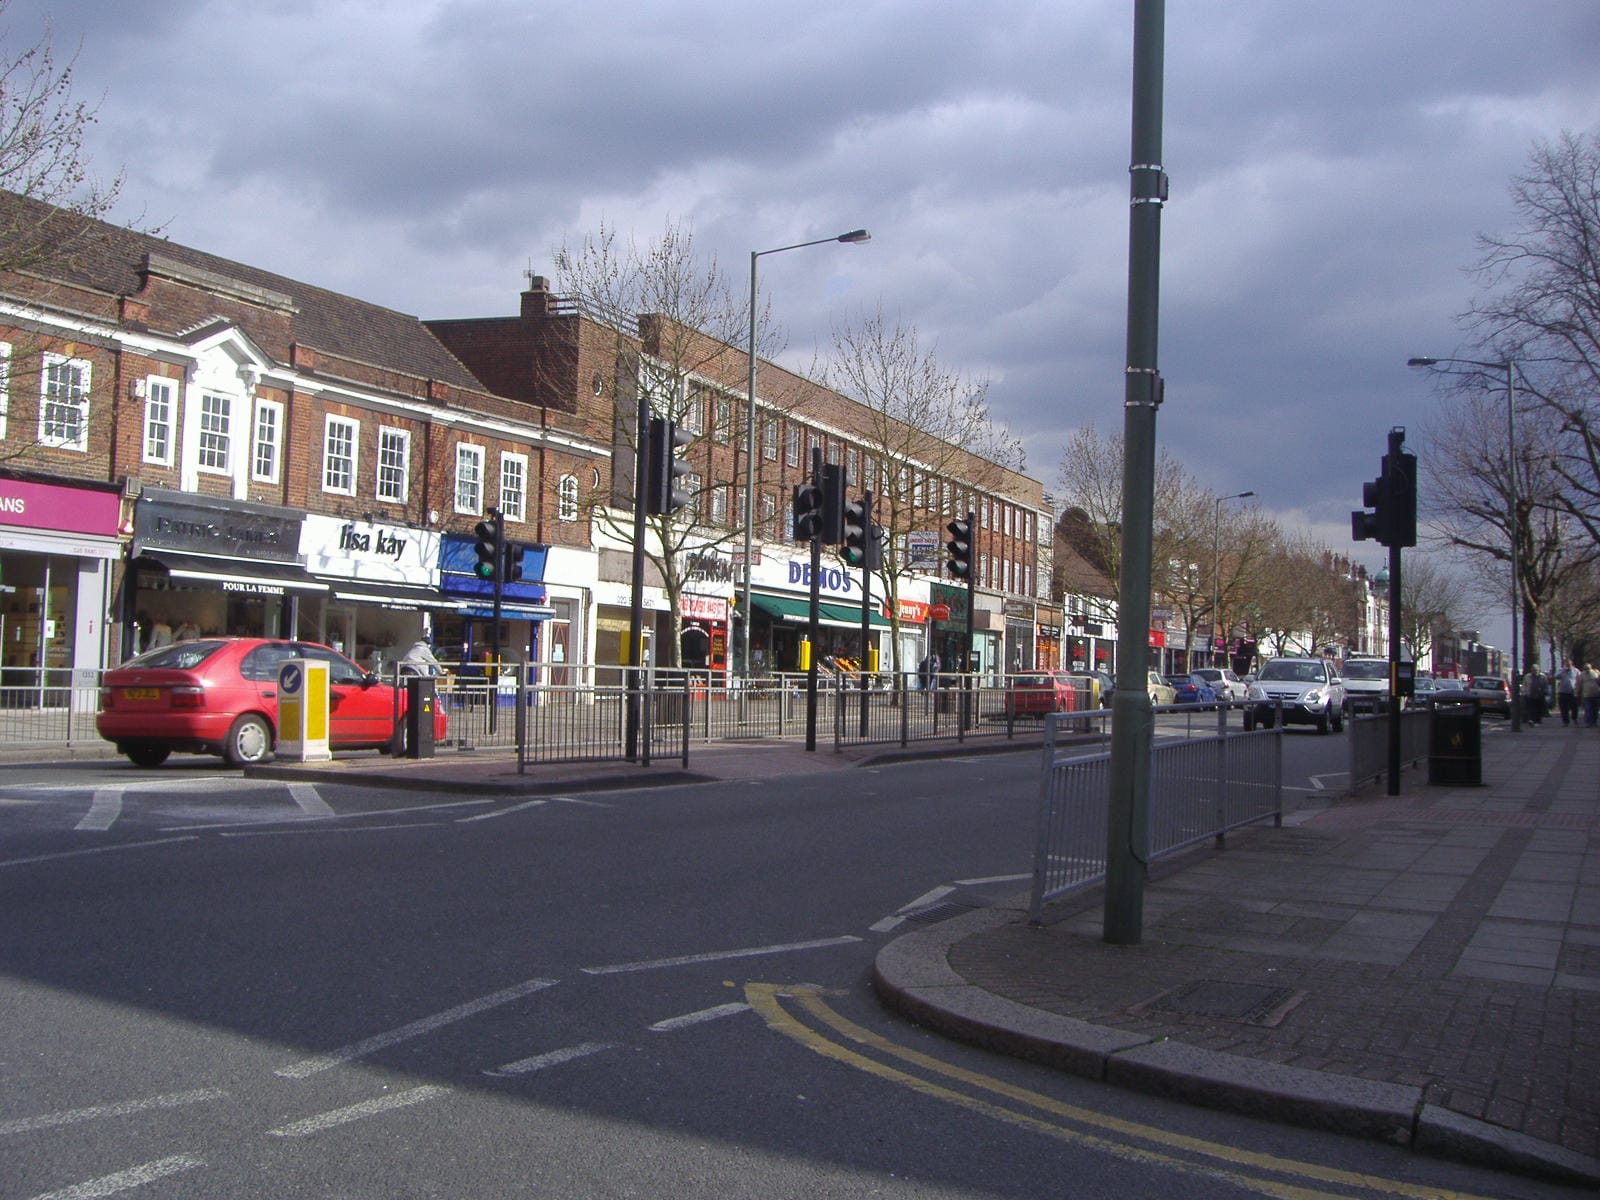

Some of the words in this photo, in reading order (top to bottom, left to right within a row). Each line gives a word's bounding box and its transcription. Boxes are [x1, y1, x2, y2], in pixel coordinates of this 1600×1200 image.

[339, 522, 371, 552] lisa
[375, 529, 407, 563] kay
[222, 581, 245, 592] POUR
[245, 584, 257, 593] LA
[257, 585, 285, 596] FEMME
